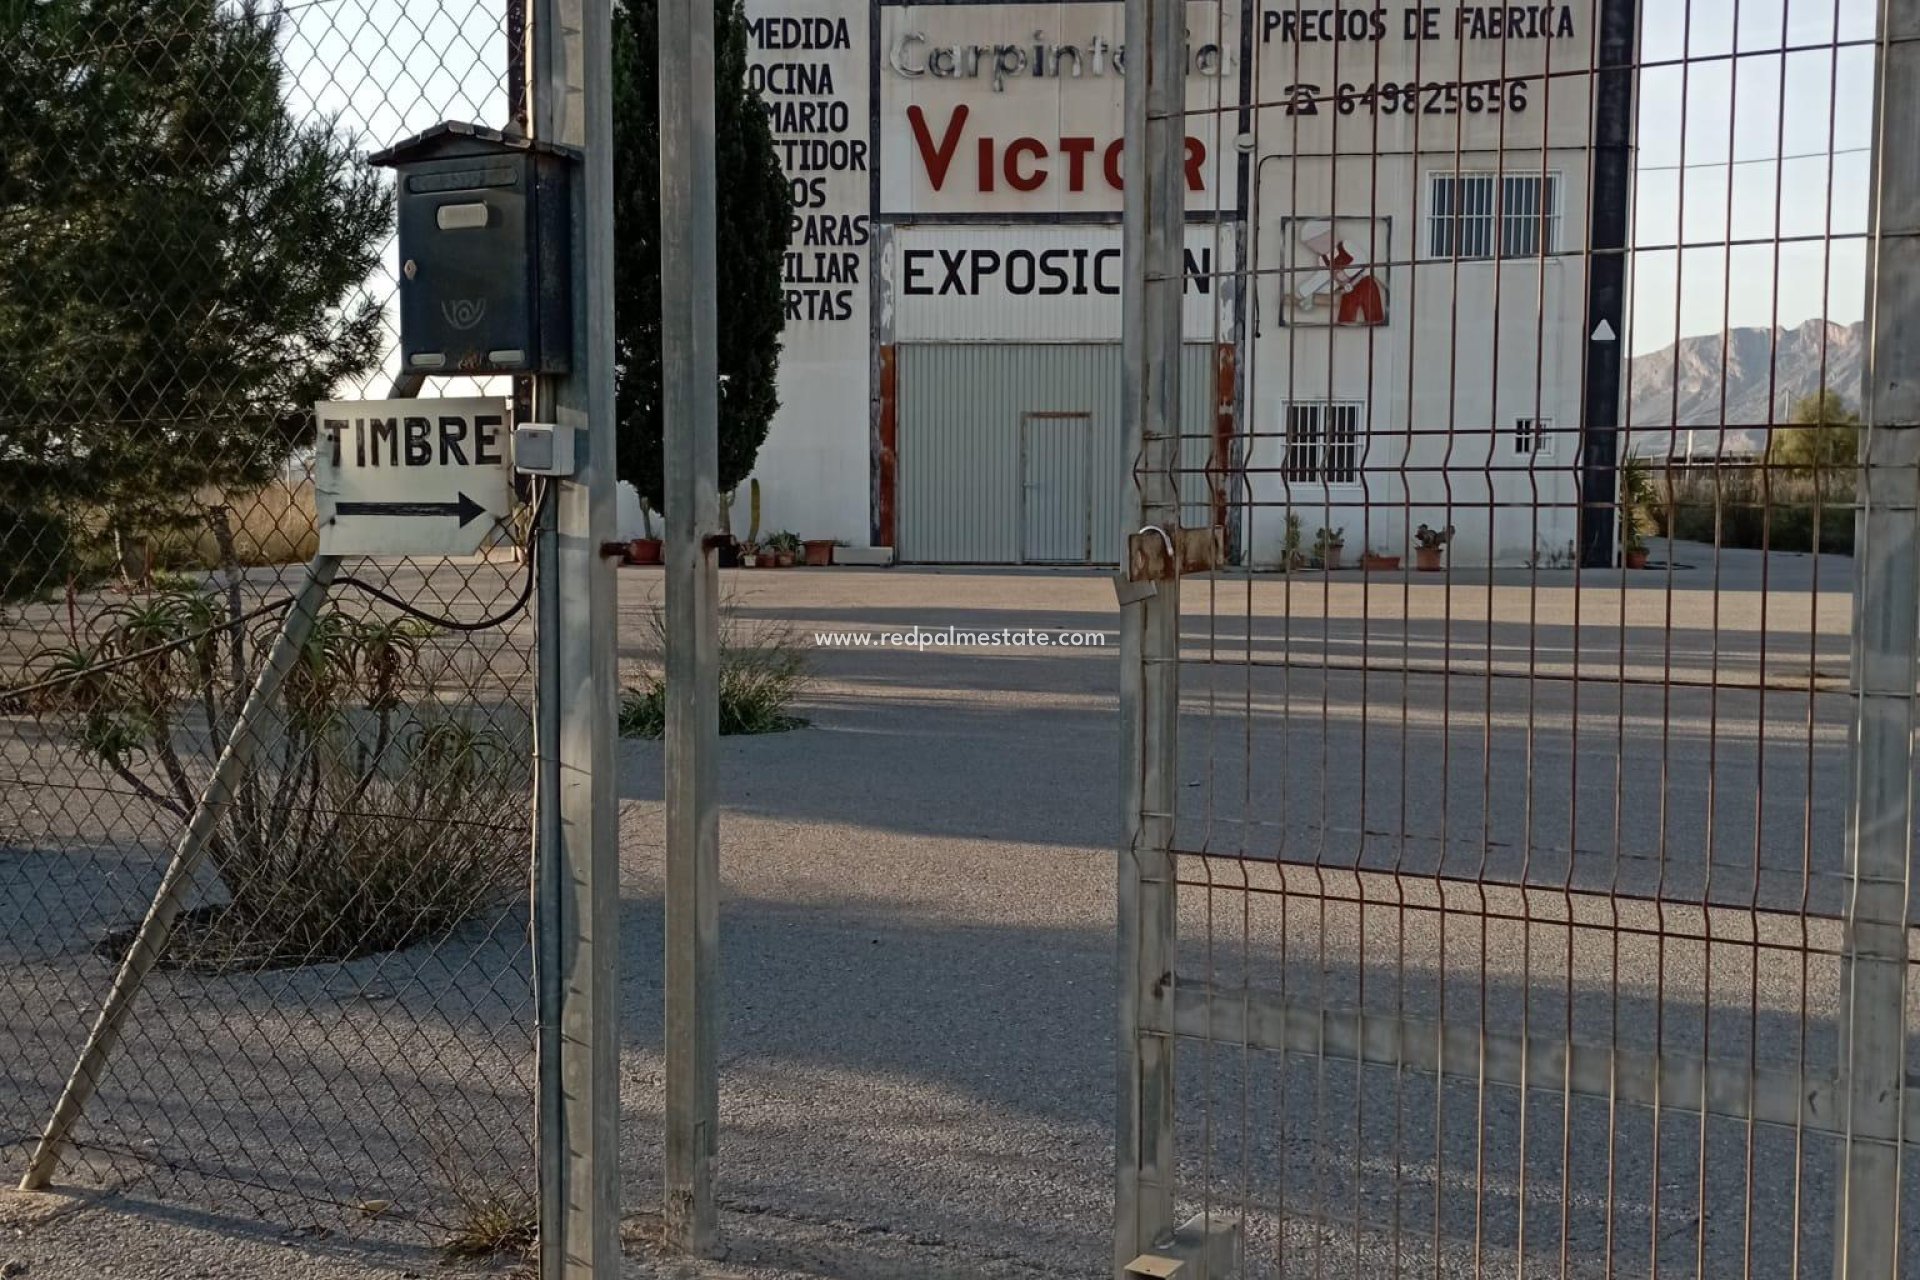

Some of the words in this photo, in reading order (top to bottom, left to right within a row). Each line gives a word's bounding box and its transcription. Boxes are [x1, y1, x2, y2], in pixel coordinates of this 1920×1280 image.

[744, 17, 850, 49] MEDIDA
[1263, 8, 1387, 42] PRECIOS
[1404, 8, 1440, 41] DE
[1455, 6, 1574, 40] FABRICA
[889, 29, 1232, 93] Carpinta
[744, 63, 834, 95] OCINA
[763, 101, 849, 133] MARIO
[785, 215, 870, 246] PARAS
[784, 252, 859, 283] ILIAR
[903, 248, 1211, 295] EXPOSICN
[785, 290, 853, 321] RTAS
[323, 415, 502, 468] TIMBRE
